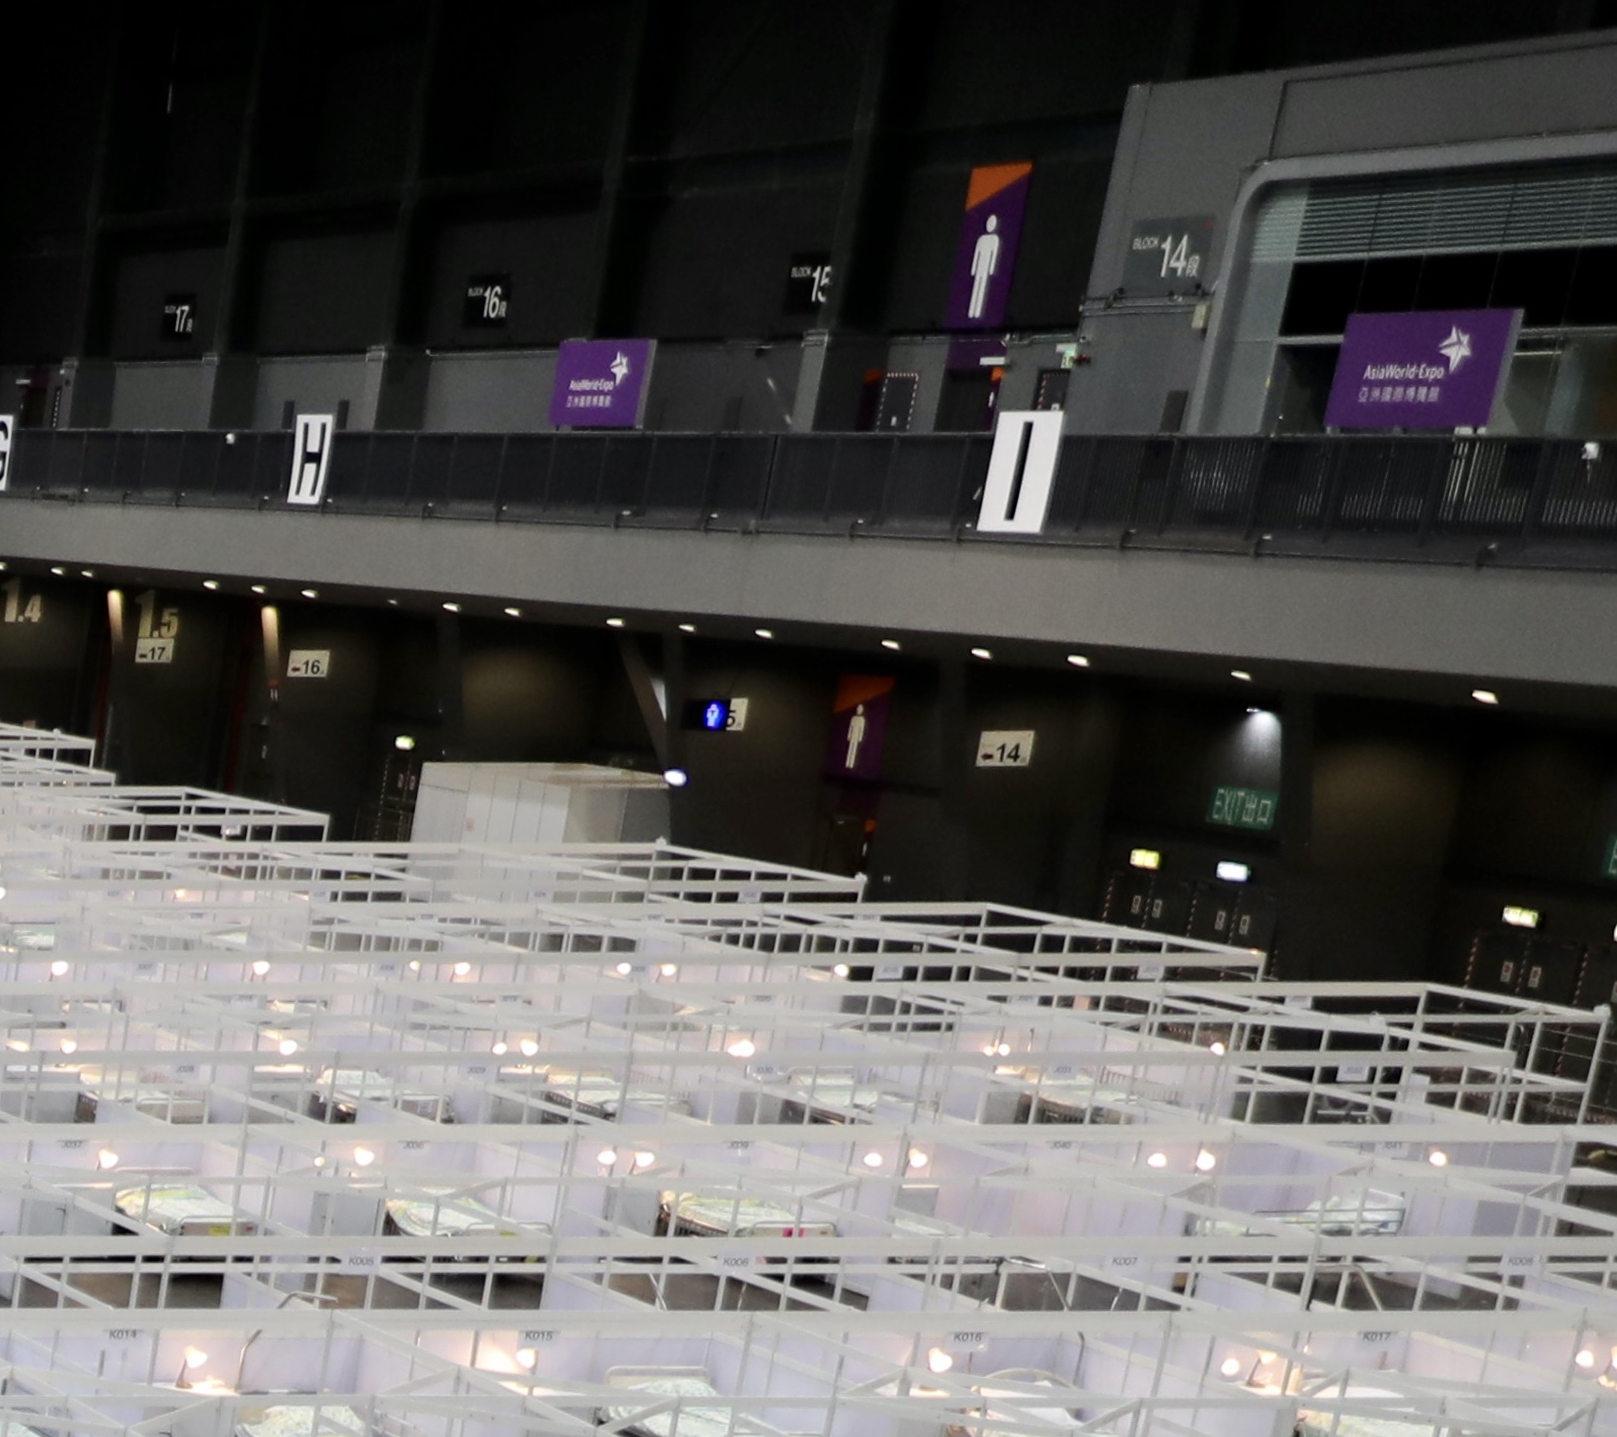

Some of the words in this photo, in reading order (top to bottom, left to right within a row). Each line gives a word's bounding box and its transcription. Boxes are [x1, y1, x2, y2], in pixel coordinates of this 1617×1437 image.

[1133, 237, 1160, 250] BLOCK
[1160, 234, 1189, 278] 14
[791, 266, 811, 278] BLOCK
[811, 265, 831, 303] 15
[483, 285, 502, 318] 16
[175, 305, 190, 332] 17
[1363, 364, 1445, 382] AsiaWorld-Expo
[295, 422, 327, 497] H
[1004, 421, 1034, 521] I
[2, 578, 41, 622] 1.4
[135, 589, 178, 638] 1.5
[148, 646, 166, 661] 17
[302, 660, 321, 676] 16
[726, 710, 736, 728] 5
[996, 742, 1021, 763] 14
[1212, 788, 1245, 822] EXIT
[1112, 1256, 1138, 1266] K007
[109, 1330, 137, 1340] K014
[524, 1330, 553, 1340] K015
[1362, 1332, 1391, 1341] K017
